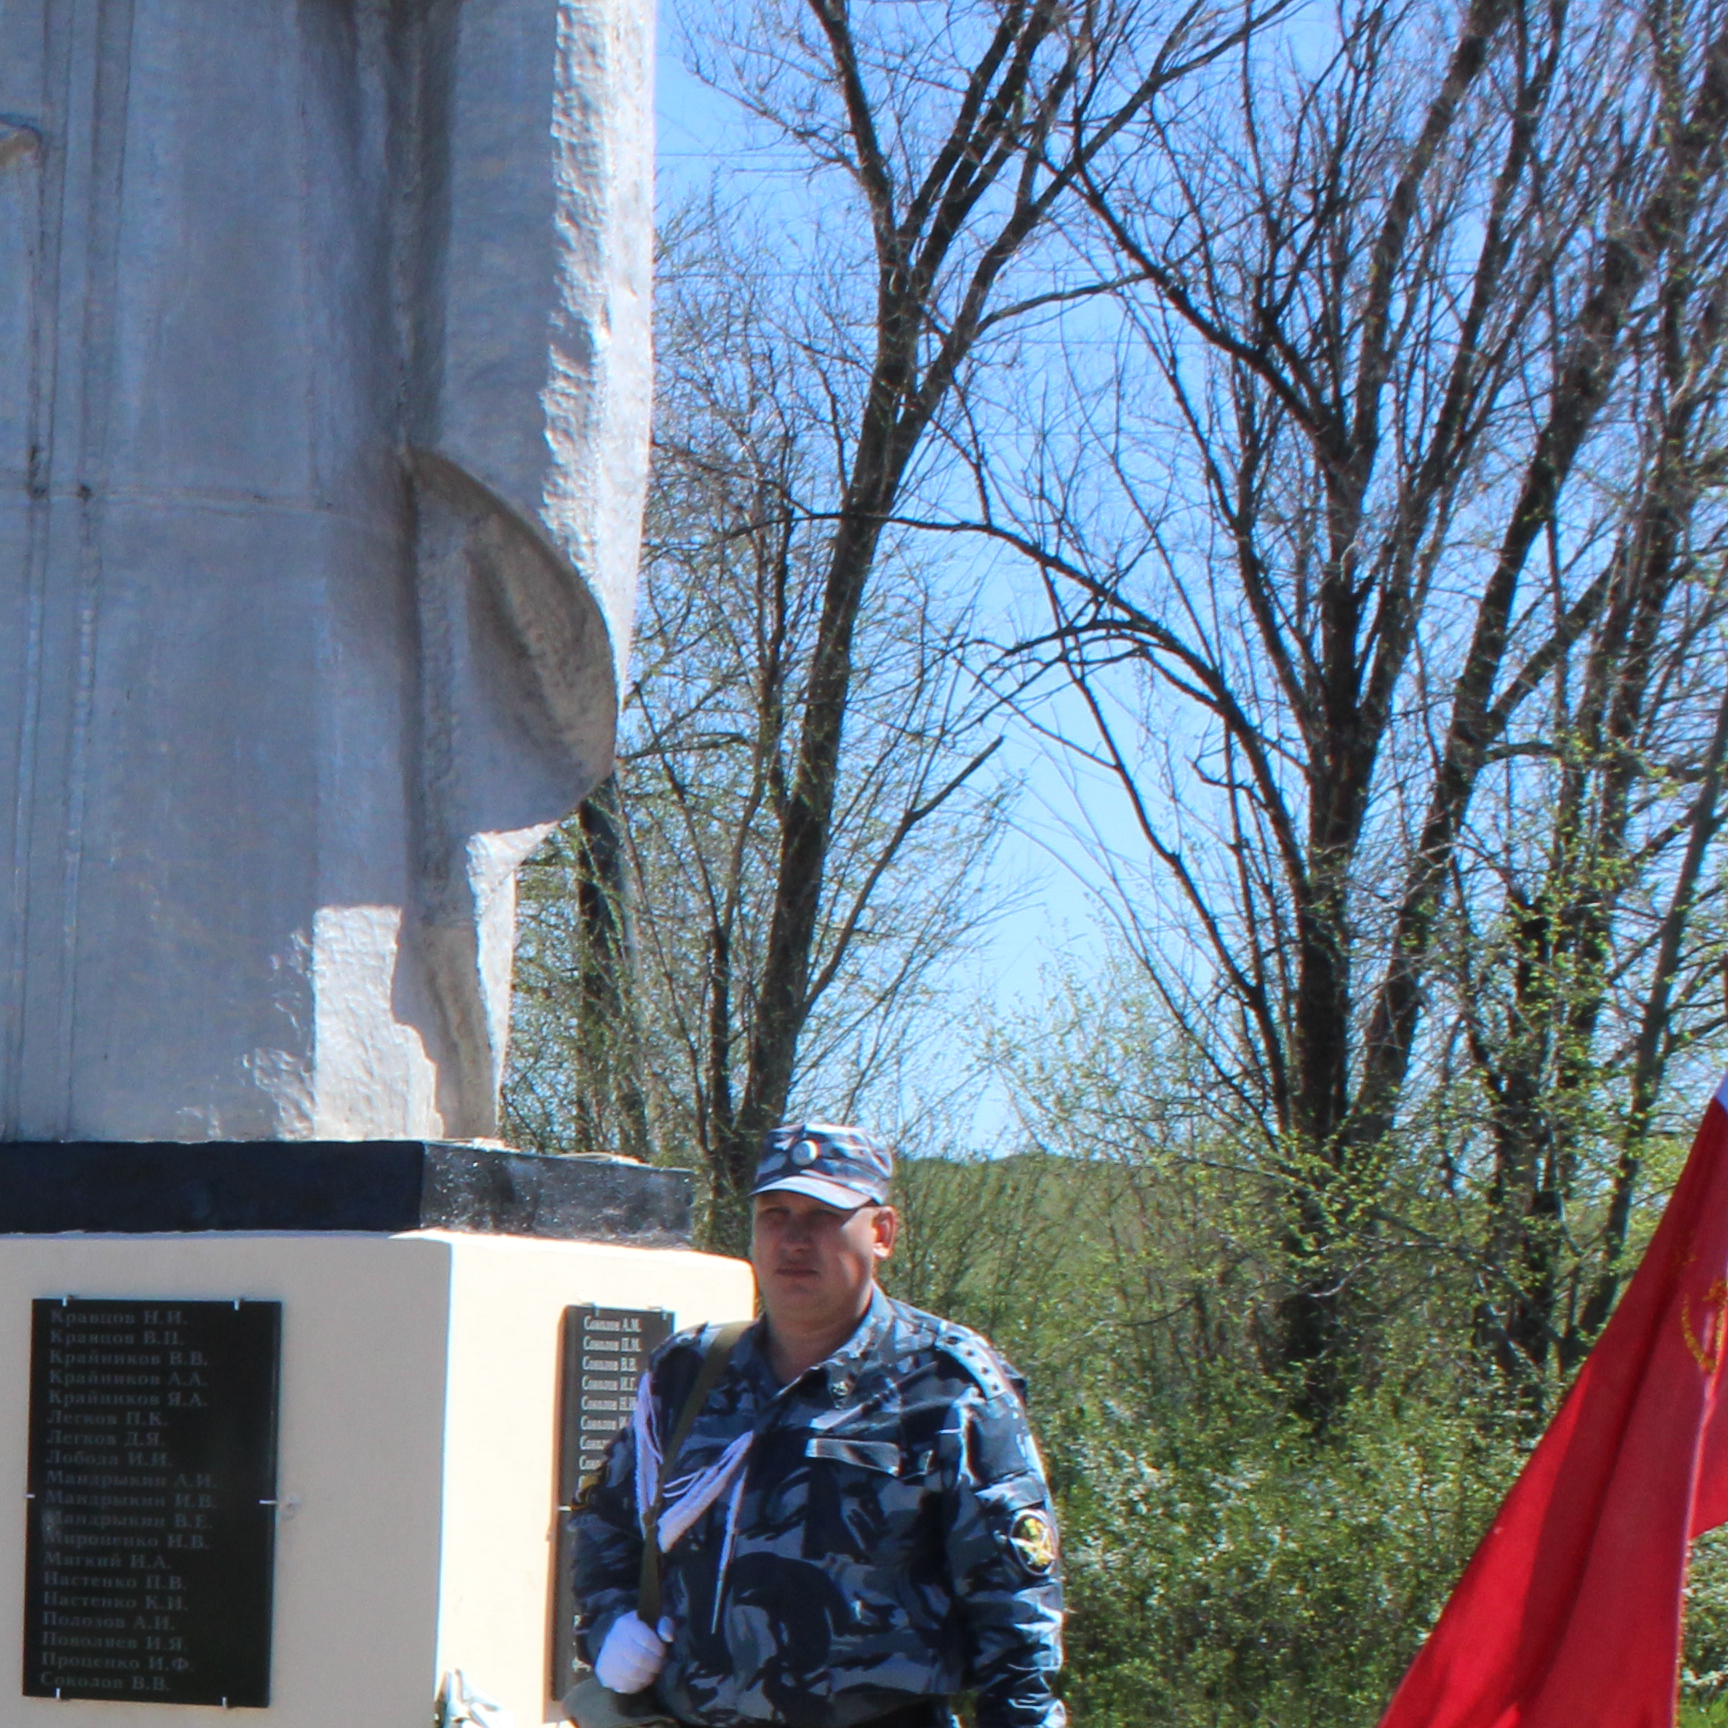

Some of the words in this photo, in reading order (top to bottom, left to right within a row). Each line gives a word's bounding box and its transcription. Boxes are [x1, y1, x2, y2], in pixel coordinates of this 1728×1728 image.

[50, 1309, 135, 1327] Кравцов
[50, 1330, 135, 1346] Кравцов
[49, 1350, 161, 1367] Крайников
[48, 1370, 161, 1387] Крайников
[48, 1390, 160, 1407] Крайников
[46, 1410, 117, 1424] Легков
[46, 1430, 117, 1445] Легков
[45, 1450, 119, 1467] Лобода
[45, 1470, 167, 1488] Мандрыкин
[45, 1490, 166, 1509] Мандрыкин
[43, 1551, 122, 1567] Мягкий
[43, 1571, 137, 1588] Настенко
[43, 1591, 137, 1608] Настенко
[42, 1611, 126, 1629] Полозов
[41, 1652, 140, 1669] Проценко
[40, 1671, 123, 1688] Соколов
